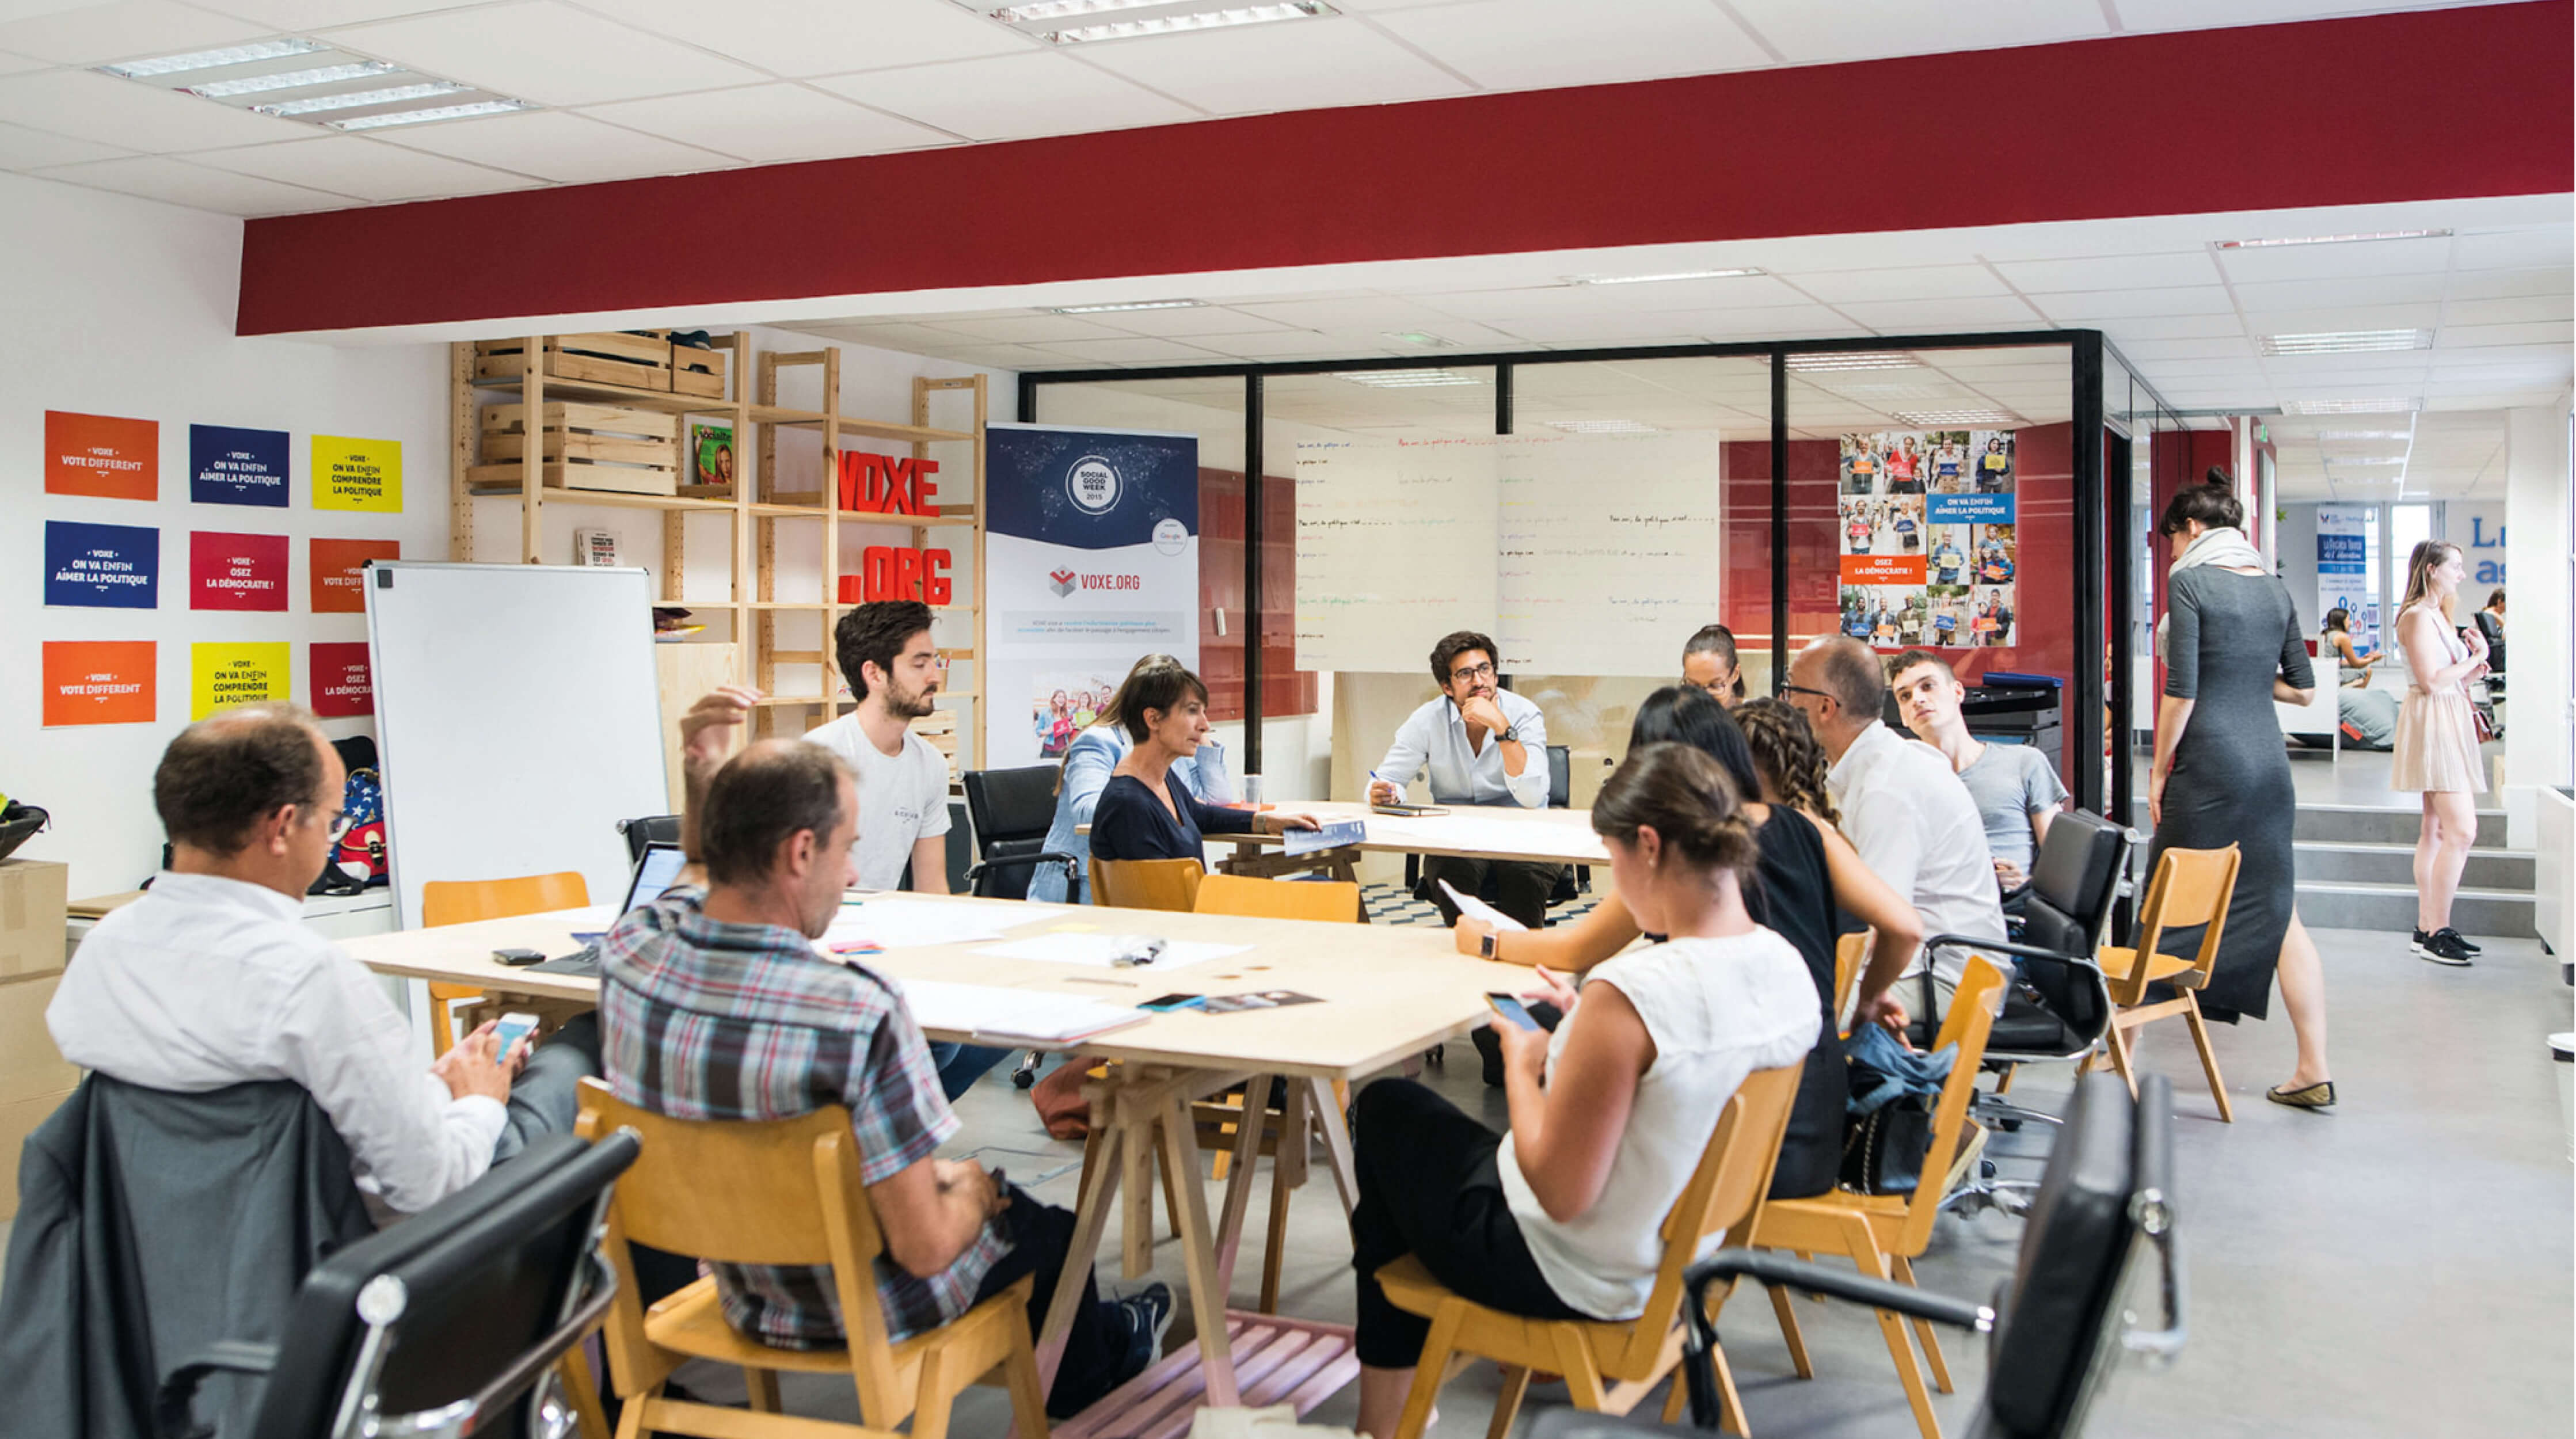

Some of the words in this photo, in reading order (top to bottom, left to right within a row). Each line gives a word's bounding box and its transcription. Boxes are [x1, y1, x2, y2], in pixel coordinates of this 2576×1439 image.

[92, 447, 113, 456] VOXE
[231, 451, 250, 460] VOXE
[61, 455, 86, 466] VOTE
[88, 458, 143, 471] DIFFERENT
[214, 460, 227, 470] ON
[228, 462, 239, 471] VA
[241, 462, 268, 473] ENFIN
[356, 465, 380, 473] ENFIN
[227, 474, 237, 483] LA
[238, 474, 281, 487] POLITIQUE
[332, 474, 382, 485] COMPRENDRE
[838, 449, 940, 518] VOXE
[333, 486, 342, 494] LA
[344, 486, 382, 498] POLITIQUE
[1086, 493, 1103, 501] 2015
[1958, 507, 1967, 515] LA
[1969, 507, 2006, 515] POLITIQUE
[92, 550, 113, 558] VOXE
[72, 559, 86, 569] ON
[88, 561, 101, 570] VA
[102, 561, 133, 571] ENFIN
[231, 557, 250, 565] VOXE
[1874, 558, 1893, 566] OSEZ
[230, 567, 252, 577] OSEZ
[1855, 567, 1865, 575] LA
[1865, 566, 1908, 575] DÉMOCRATIE
[87, 573, 98, 583] LA
[100, 573, 148, 587] POLITIQUE
[206, 578, 218, 588] LA
[218, 577, 269, 589] DÉMOCRATIE
[323, 577, 343, 585] VOTE
[1080, 574, 1140, 590] VOXE.ORG
[90, 673, 112, 682] VOXE
[214, 671, 227, 679] ON
[229, 671, 239, 679] VA
[241, 671, 267, 679] ENFIN
[345, 675, 366, 684] OSEZ
[60, 685, 85, 695] VOTE
[86, 684, 142, 694] DIFFERENT
[213, 683, 268, 692] COMPRENDRE
[325, 687, 334, 695] LA
[214, 694, 225, 703] LA
